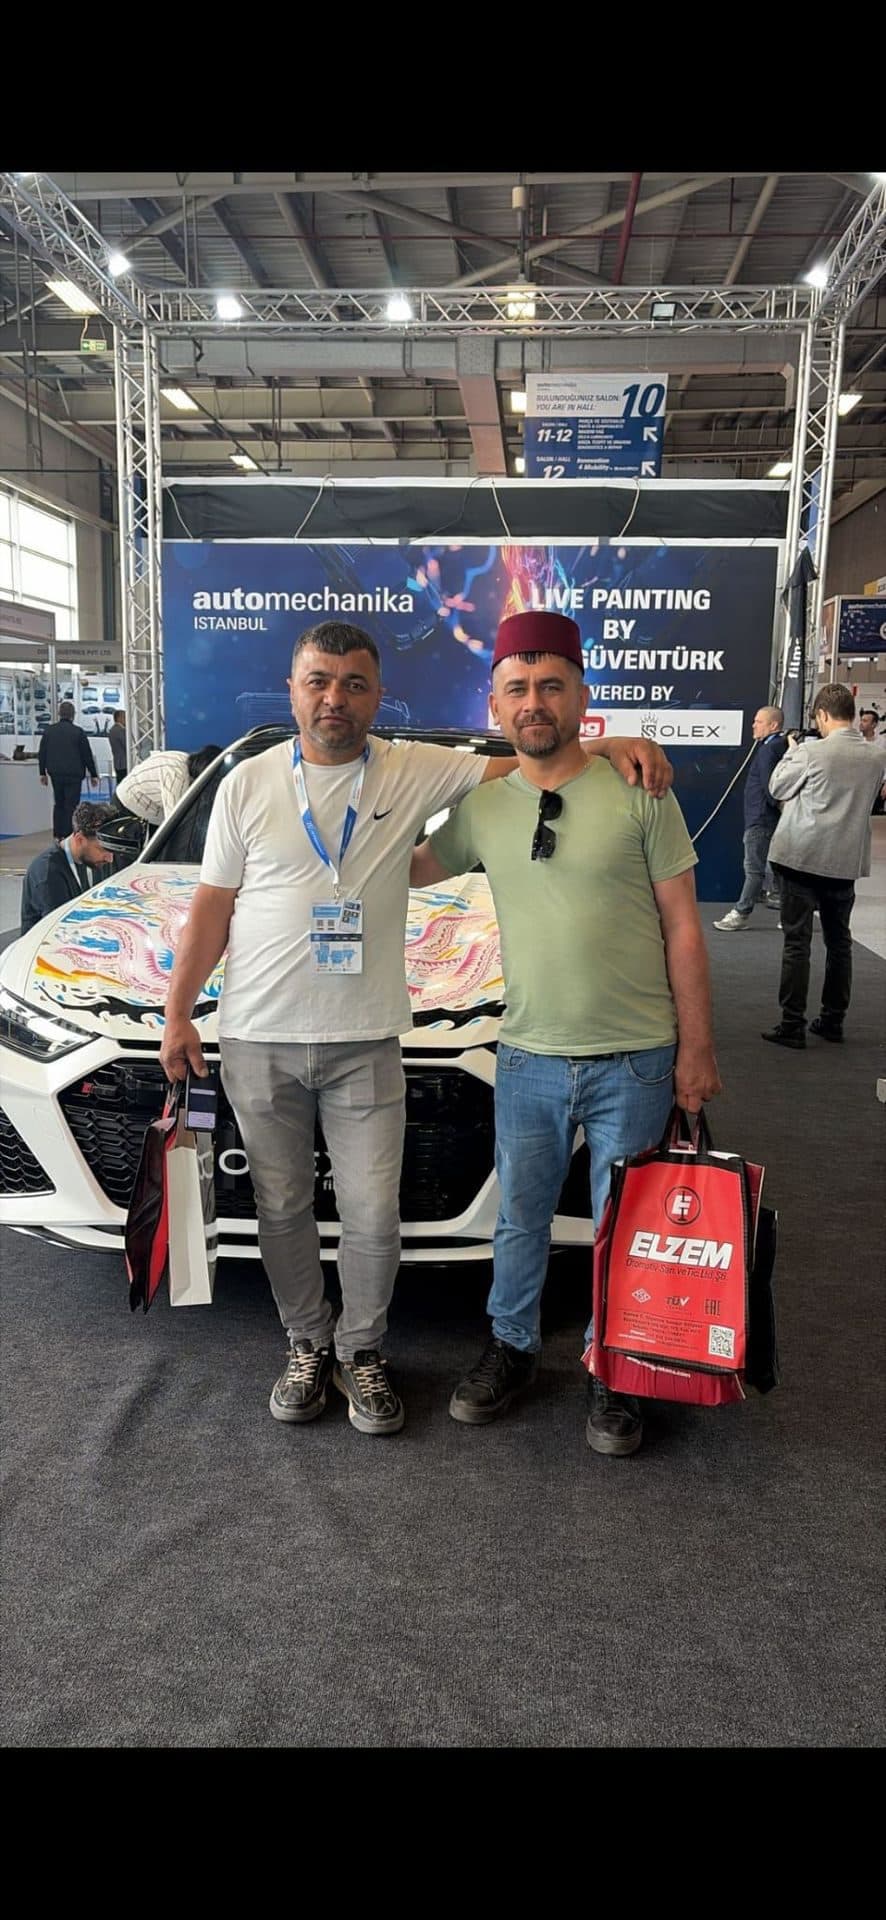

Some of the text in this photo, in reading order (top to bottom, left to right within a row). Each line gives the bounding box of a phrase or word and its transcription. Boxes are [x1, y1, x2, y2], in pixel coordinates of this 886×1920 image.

[622, 383, 665, 417] 10
[536, 429, 574, 442] 11-12
[543, 465, 565, 478] 12
[193, 586, 414, 612] automechanika
[530, 588, 712, 610] LIVE PAINTING
[194, 616, 268, 631] ISTANBUL
[603, 619, 636, 640] BY
[651, 685, 674, 701] BY
[627, 1231, 734, 1270] ELZEM
